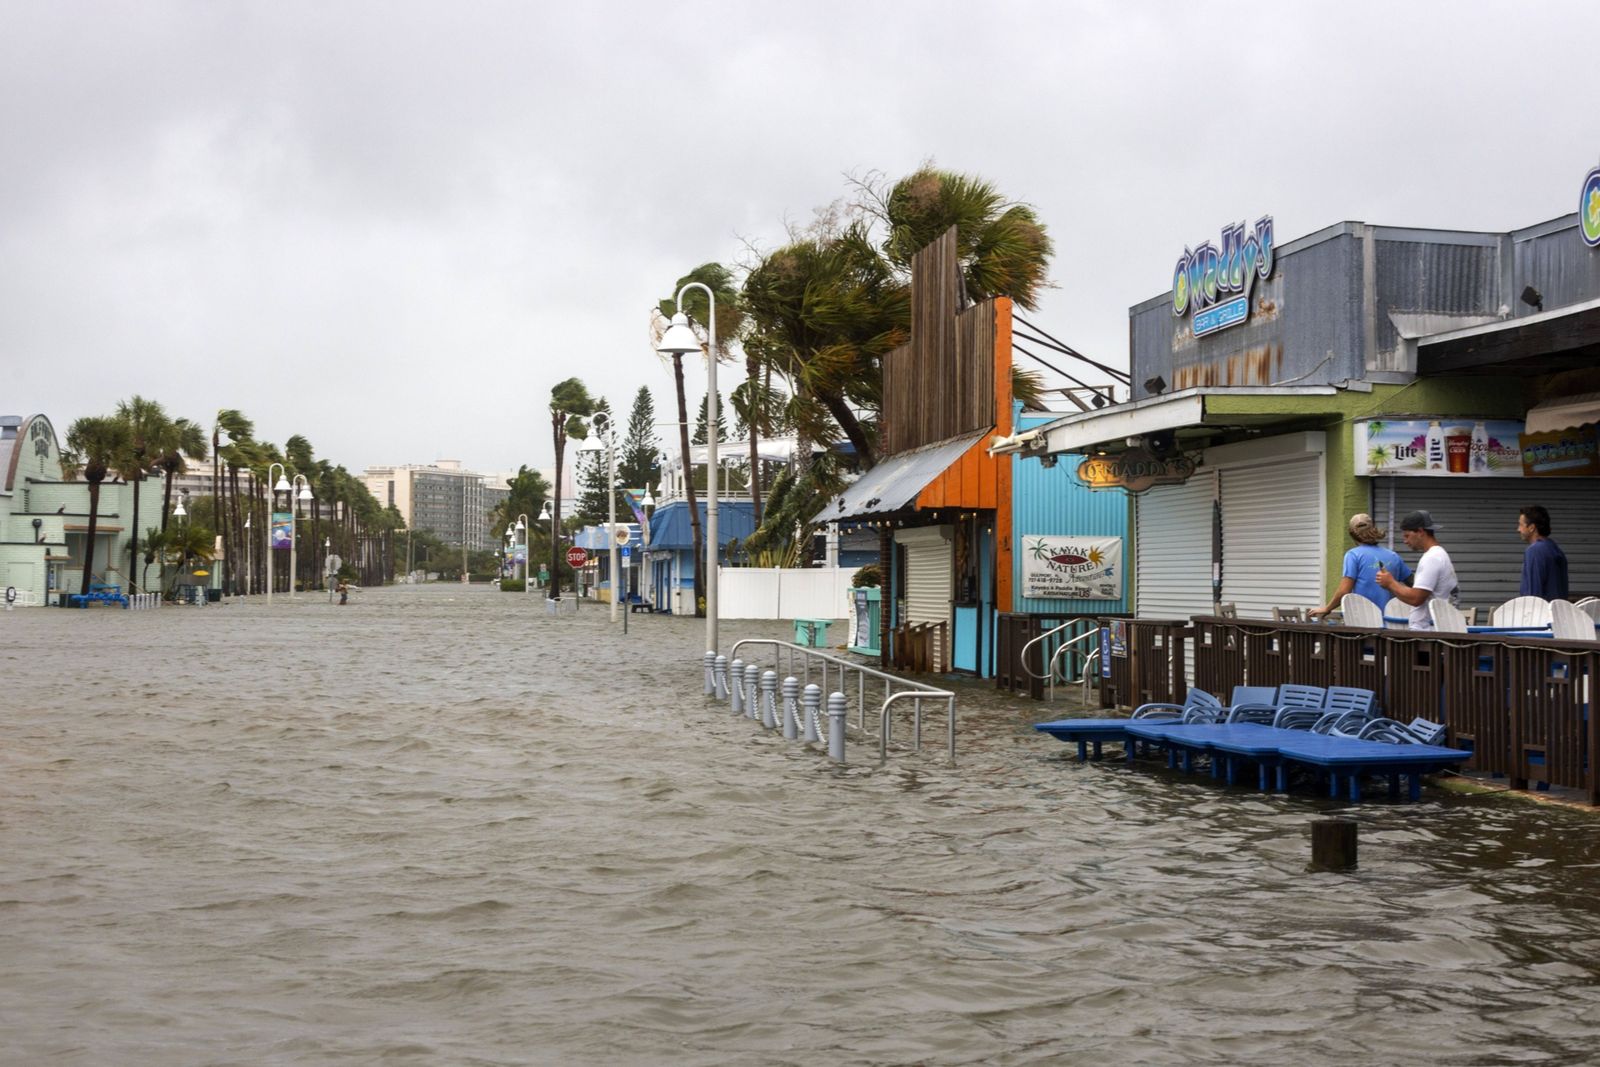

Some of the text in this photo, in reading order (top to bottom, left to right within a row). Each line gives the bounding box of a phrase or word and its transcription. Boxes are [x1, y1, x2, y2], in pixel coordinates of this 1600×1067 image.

[1394, 445, 1418, 460] Lite
[1430, 438, 1443, 462] Lite
[568, 553, 585, 561] STOP
[1050, 546, 1088, 557] KAYAK
[1047, 561, 1094, 573] NATURE
